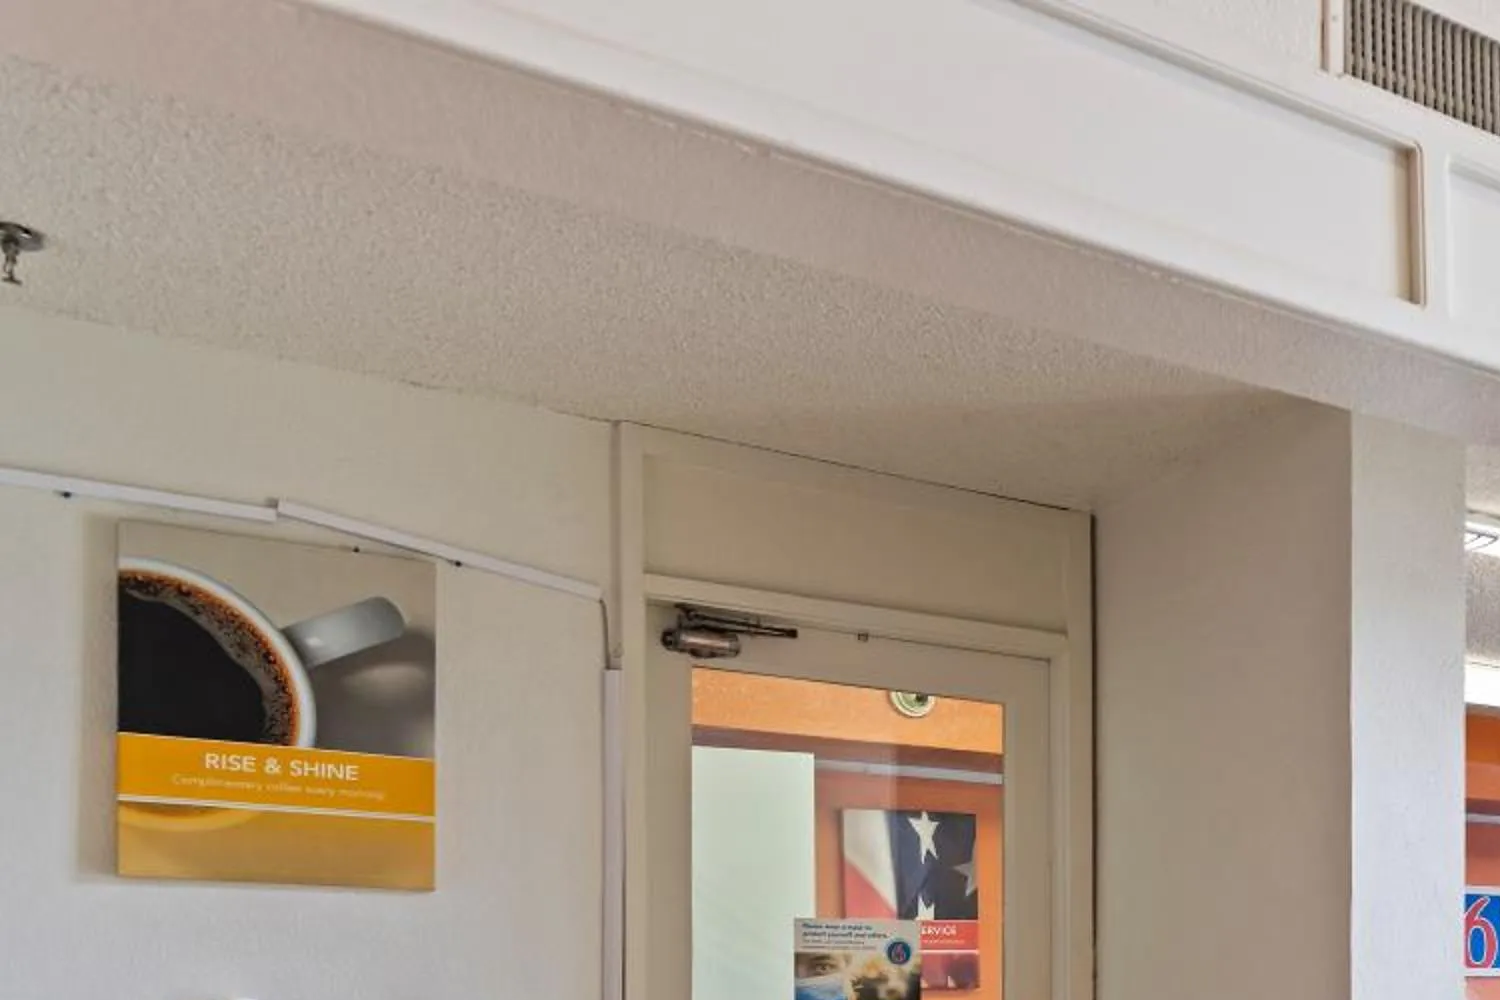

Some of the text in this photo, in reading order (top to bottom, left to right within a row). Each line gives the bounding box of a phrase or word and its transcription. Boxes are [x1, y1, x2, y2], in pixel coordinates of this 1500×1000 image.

[204, 752, 360, 781] RISE & SHINE
[921, 924, 957, 936] ERVICE
[1464, 896, 1498, 969] 6
